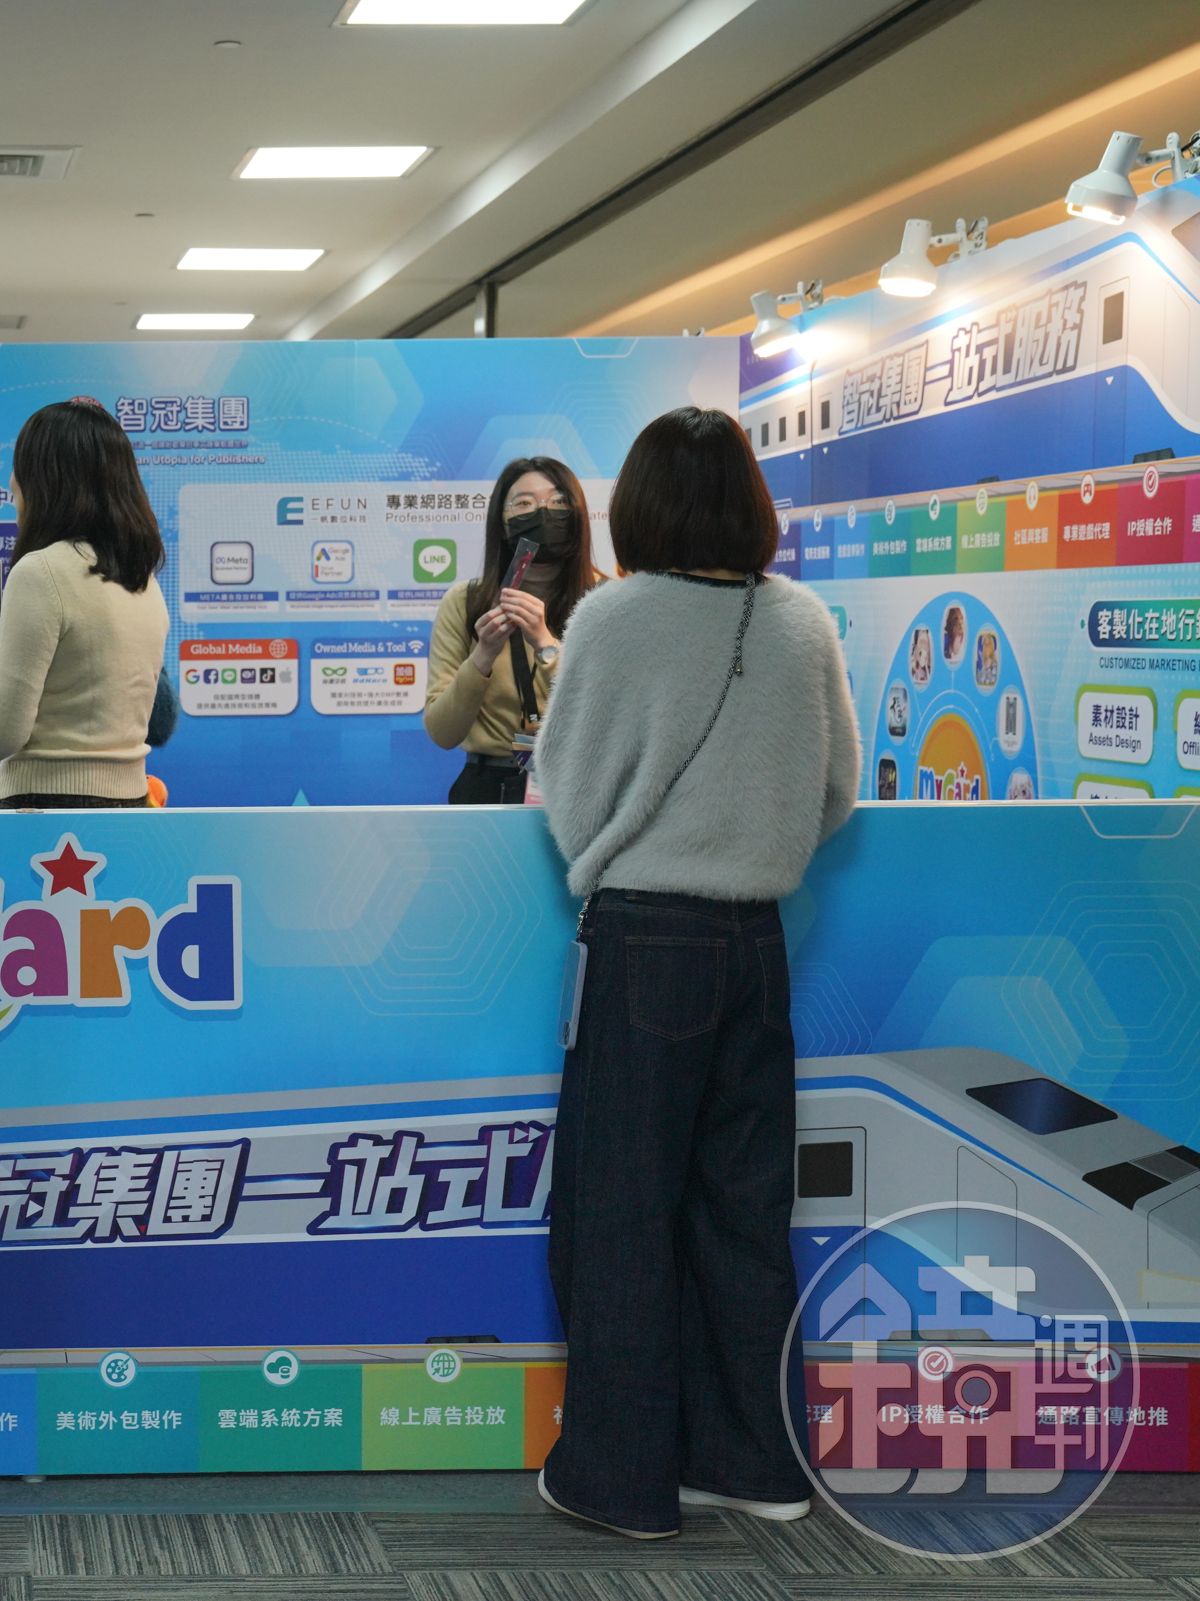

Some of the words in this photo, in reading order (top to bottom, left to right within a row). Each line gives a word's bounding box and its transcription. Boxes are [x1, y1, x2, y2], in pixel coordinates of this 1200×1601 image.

[839, 280, 1087, 436] 智冠集團一站式服務
[116, 396, 249, 432] 智冠集團
[152, 455, 188, 468] Utopia
[191, 455, 205, 465] for
[208, 454, 265, 465] Publishers
[386, 493, 487, 510] 專業網路整合
[385, 512, 460, 524] Professional
[1128, 518, 1172, 537] IP授權合作
[227, 557, 249, 565] Meta
[423, 554, 446, 564] LINE
[191, 644, 225, 655] Global
[228, 643, 262, 654] Media
[314, 643, 347, 653] Owned
[349, 643, 376, 653] Media
[387, 642, 406, 652] Tool
[1100, 656, 1146, 670] CUSTOMIZED
[1148, 659, 1196, 672] MARKETING
[1091, 704, 1139, 731] 素材設計
[1088, 732, 1113, 747] Assets
[1115, 734, 1141, 752] Design
[56, 1410, 182, 1431] 美術外包製作
[217, 1407, 343, 1430] 雲端系統方案
[380, 1405, 506, 1428] 線上廣告投放
[881, 1404, 989, 1426] IP授權合作
[1037, 1405, 1168, 1427] 通路宣傳地推
